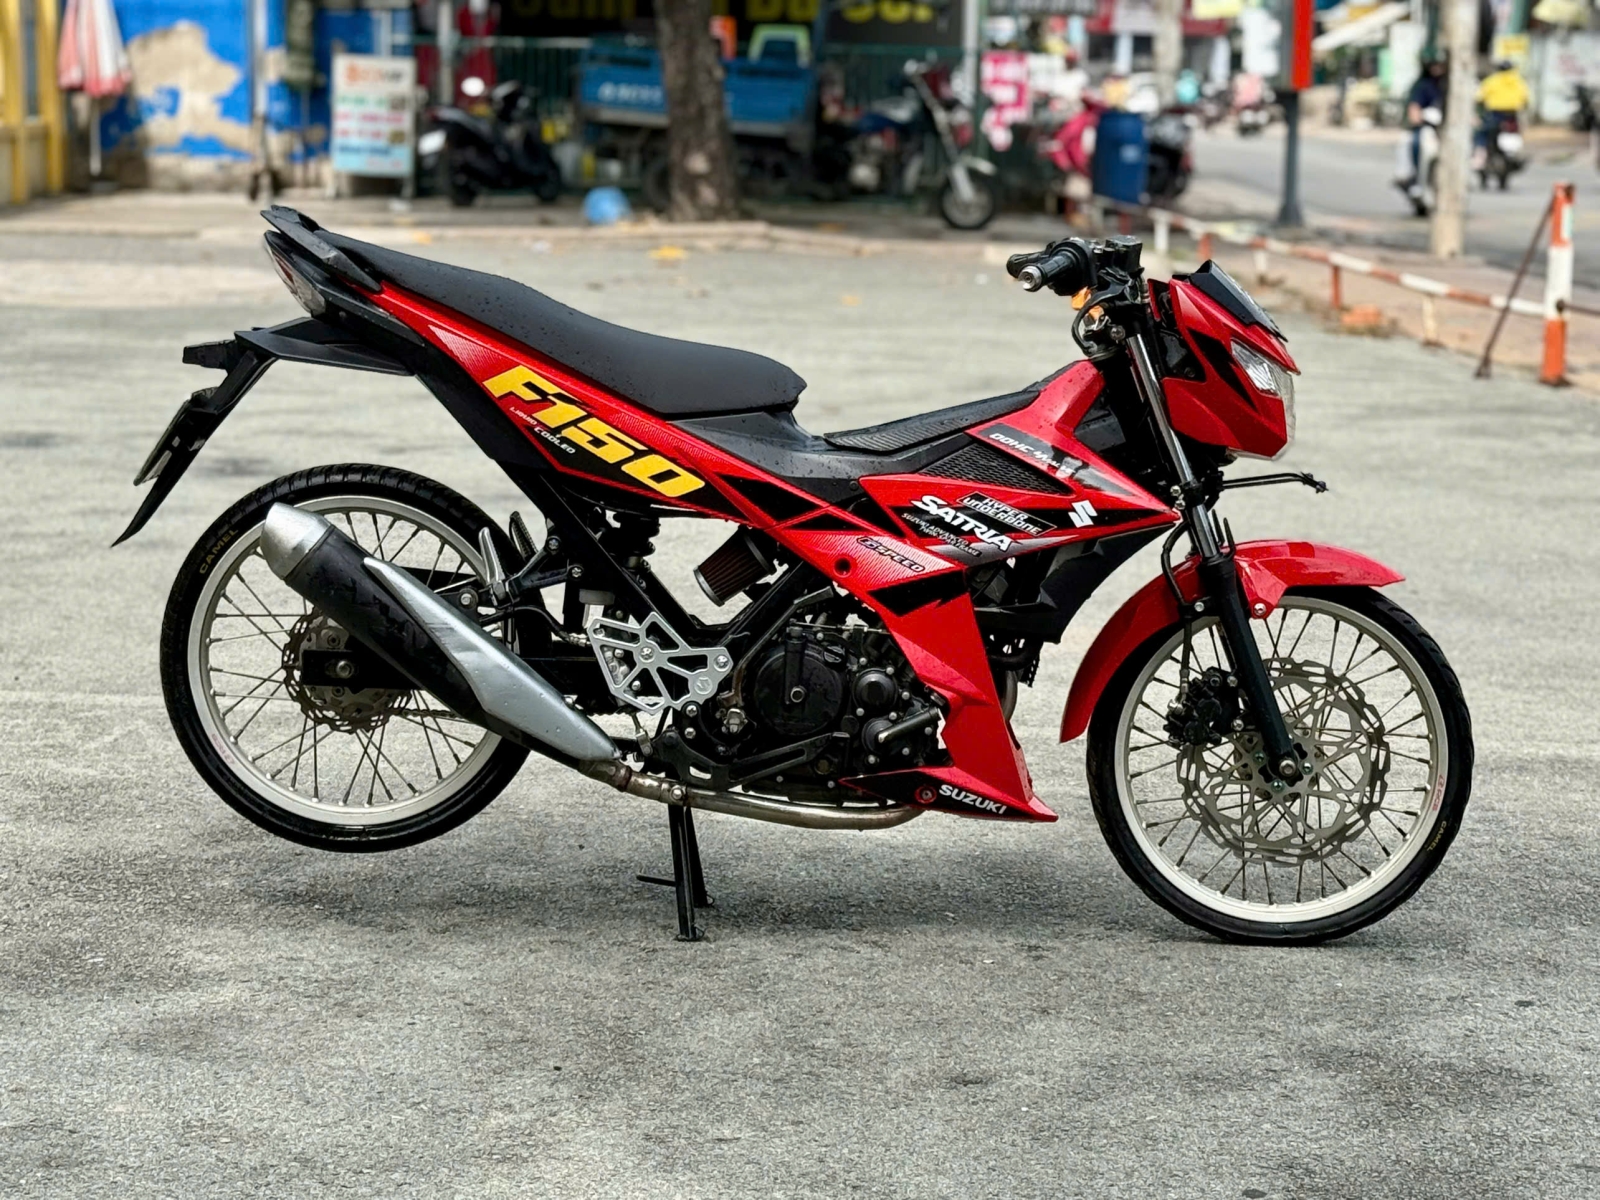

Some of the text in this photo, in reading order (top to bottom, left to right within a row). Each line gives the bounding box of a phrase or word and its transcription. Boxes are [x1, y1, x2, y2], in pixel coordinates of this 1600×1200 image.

[482, 364, 706, 498] F150
[509, 406, 576, 454] LIQUID COOLED
[988, 432, 1035, 453] DOHC
[901, 512, 930, 529] SUZUKI
[911, 495, 1014, 552] SATRIA
[982, 496, 1029, 521] HYPER
[199, 529, 239, 575] CAMEL
[938, 784, 1008, 815] SUZUKI
[1426, 820, 1447, 851] CAMEL
